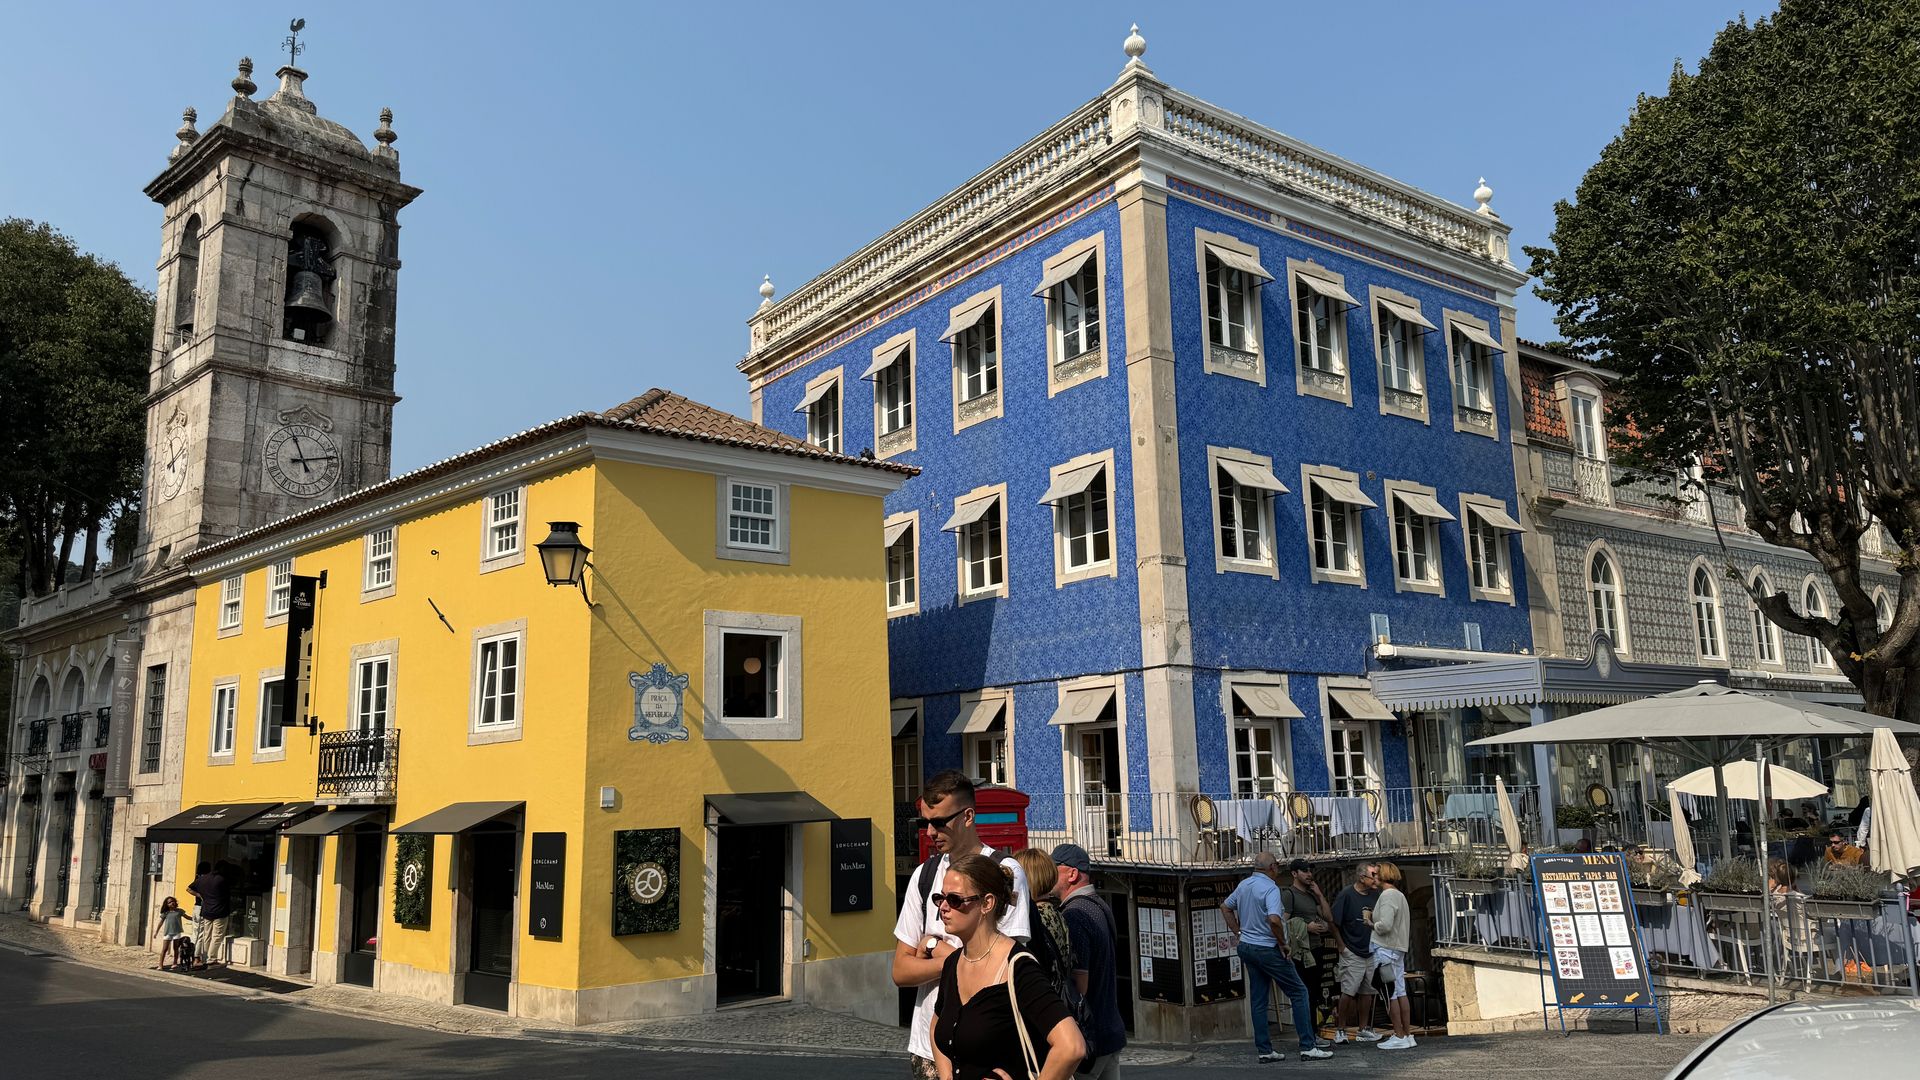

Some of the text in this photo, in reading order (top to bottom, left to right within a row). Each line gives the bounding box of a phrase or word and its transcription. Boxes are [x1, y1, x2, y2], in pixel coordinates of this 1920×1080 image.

[650, 694, 668, 703] PRAÇA
[1582, 854, 1618, 865] MENU
[840, 863, 866, 871] MaxMara
[1541, 872, 1581, 881] RESTAURANTE
[1584, 871, 1602, 880] TAPAS
[1605, 871, 1618, 880] BAR
